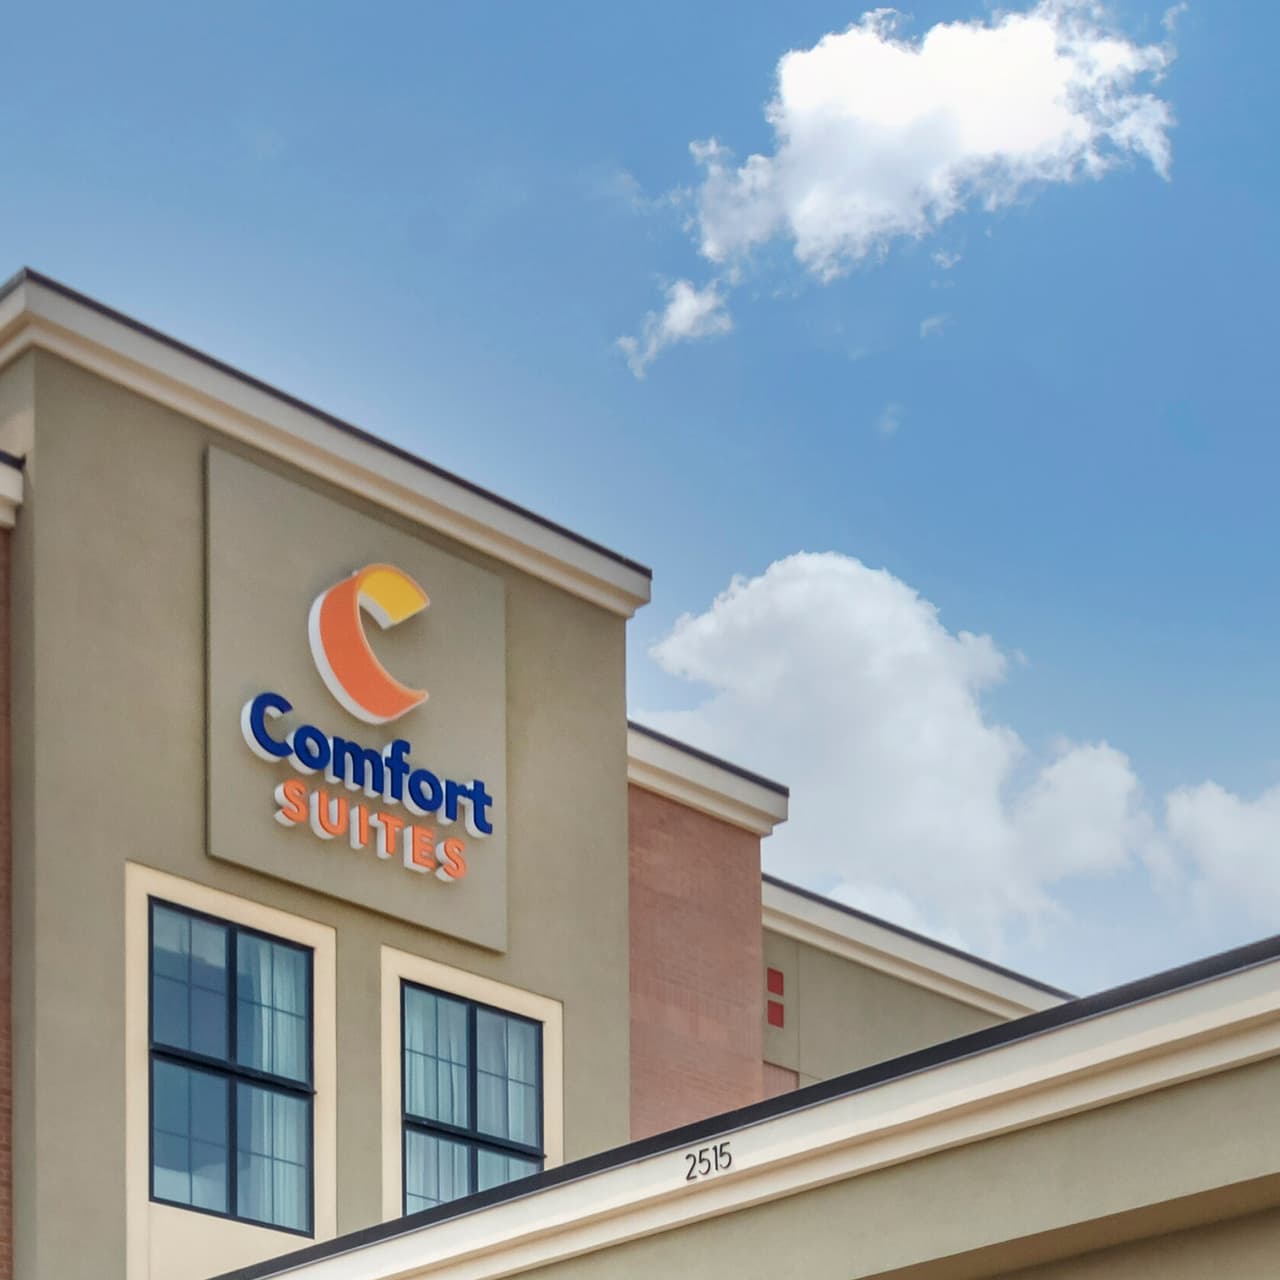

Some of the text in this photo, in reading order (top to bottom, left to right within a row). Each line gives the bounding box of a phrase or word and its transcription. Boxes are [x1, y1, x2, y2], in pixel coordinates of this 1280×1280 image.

[242, 692, 493, 838] Comfort
[275, 779, 467, 882] SUITES
[685, 1142, 732, 1181] 2515
